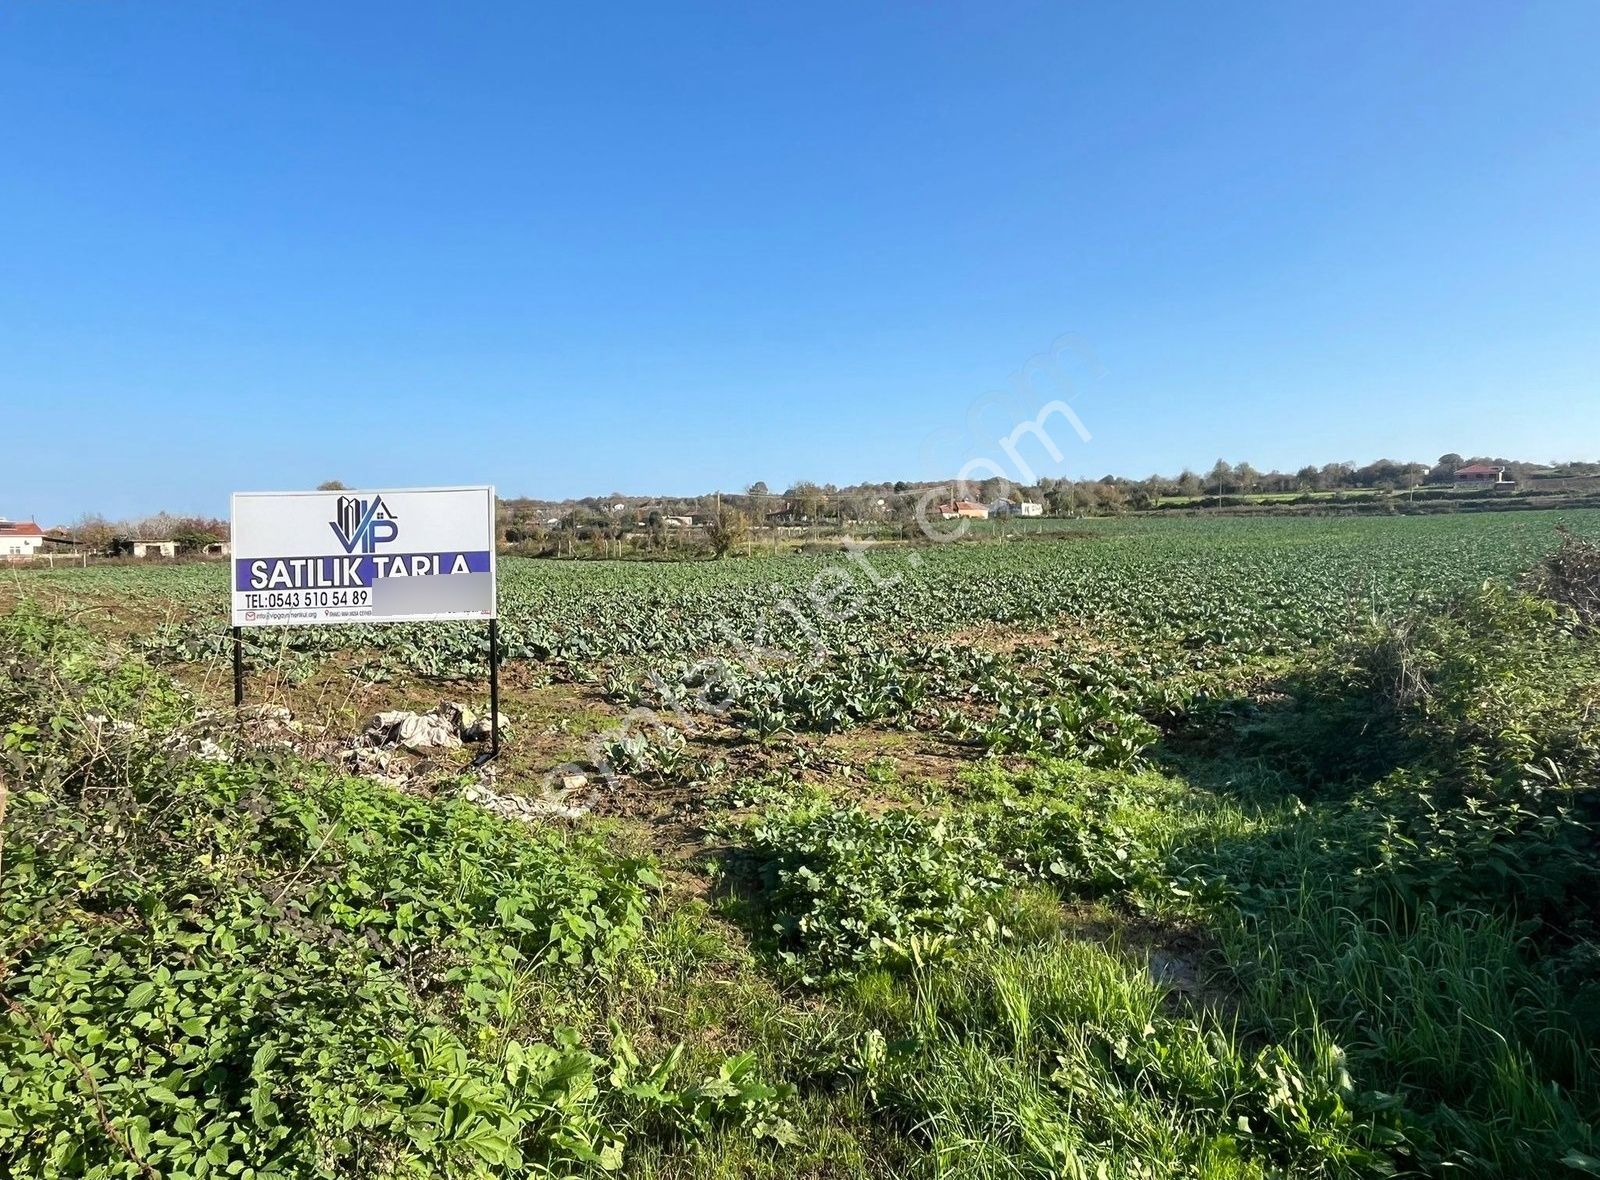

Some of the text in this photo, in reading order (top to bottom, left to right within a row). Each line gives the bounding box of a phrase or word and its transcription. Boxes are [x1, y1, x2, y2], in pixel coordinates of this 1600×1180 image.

[328, 494, 399, 554] VIP
[250, 557, 364, 590] SATILIK
[245, 590, 368, 609] TEL:0543 510 54 89
